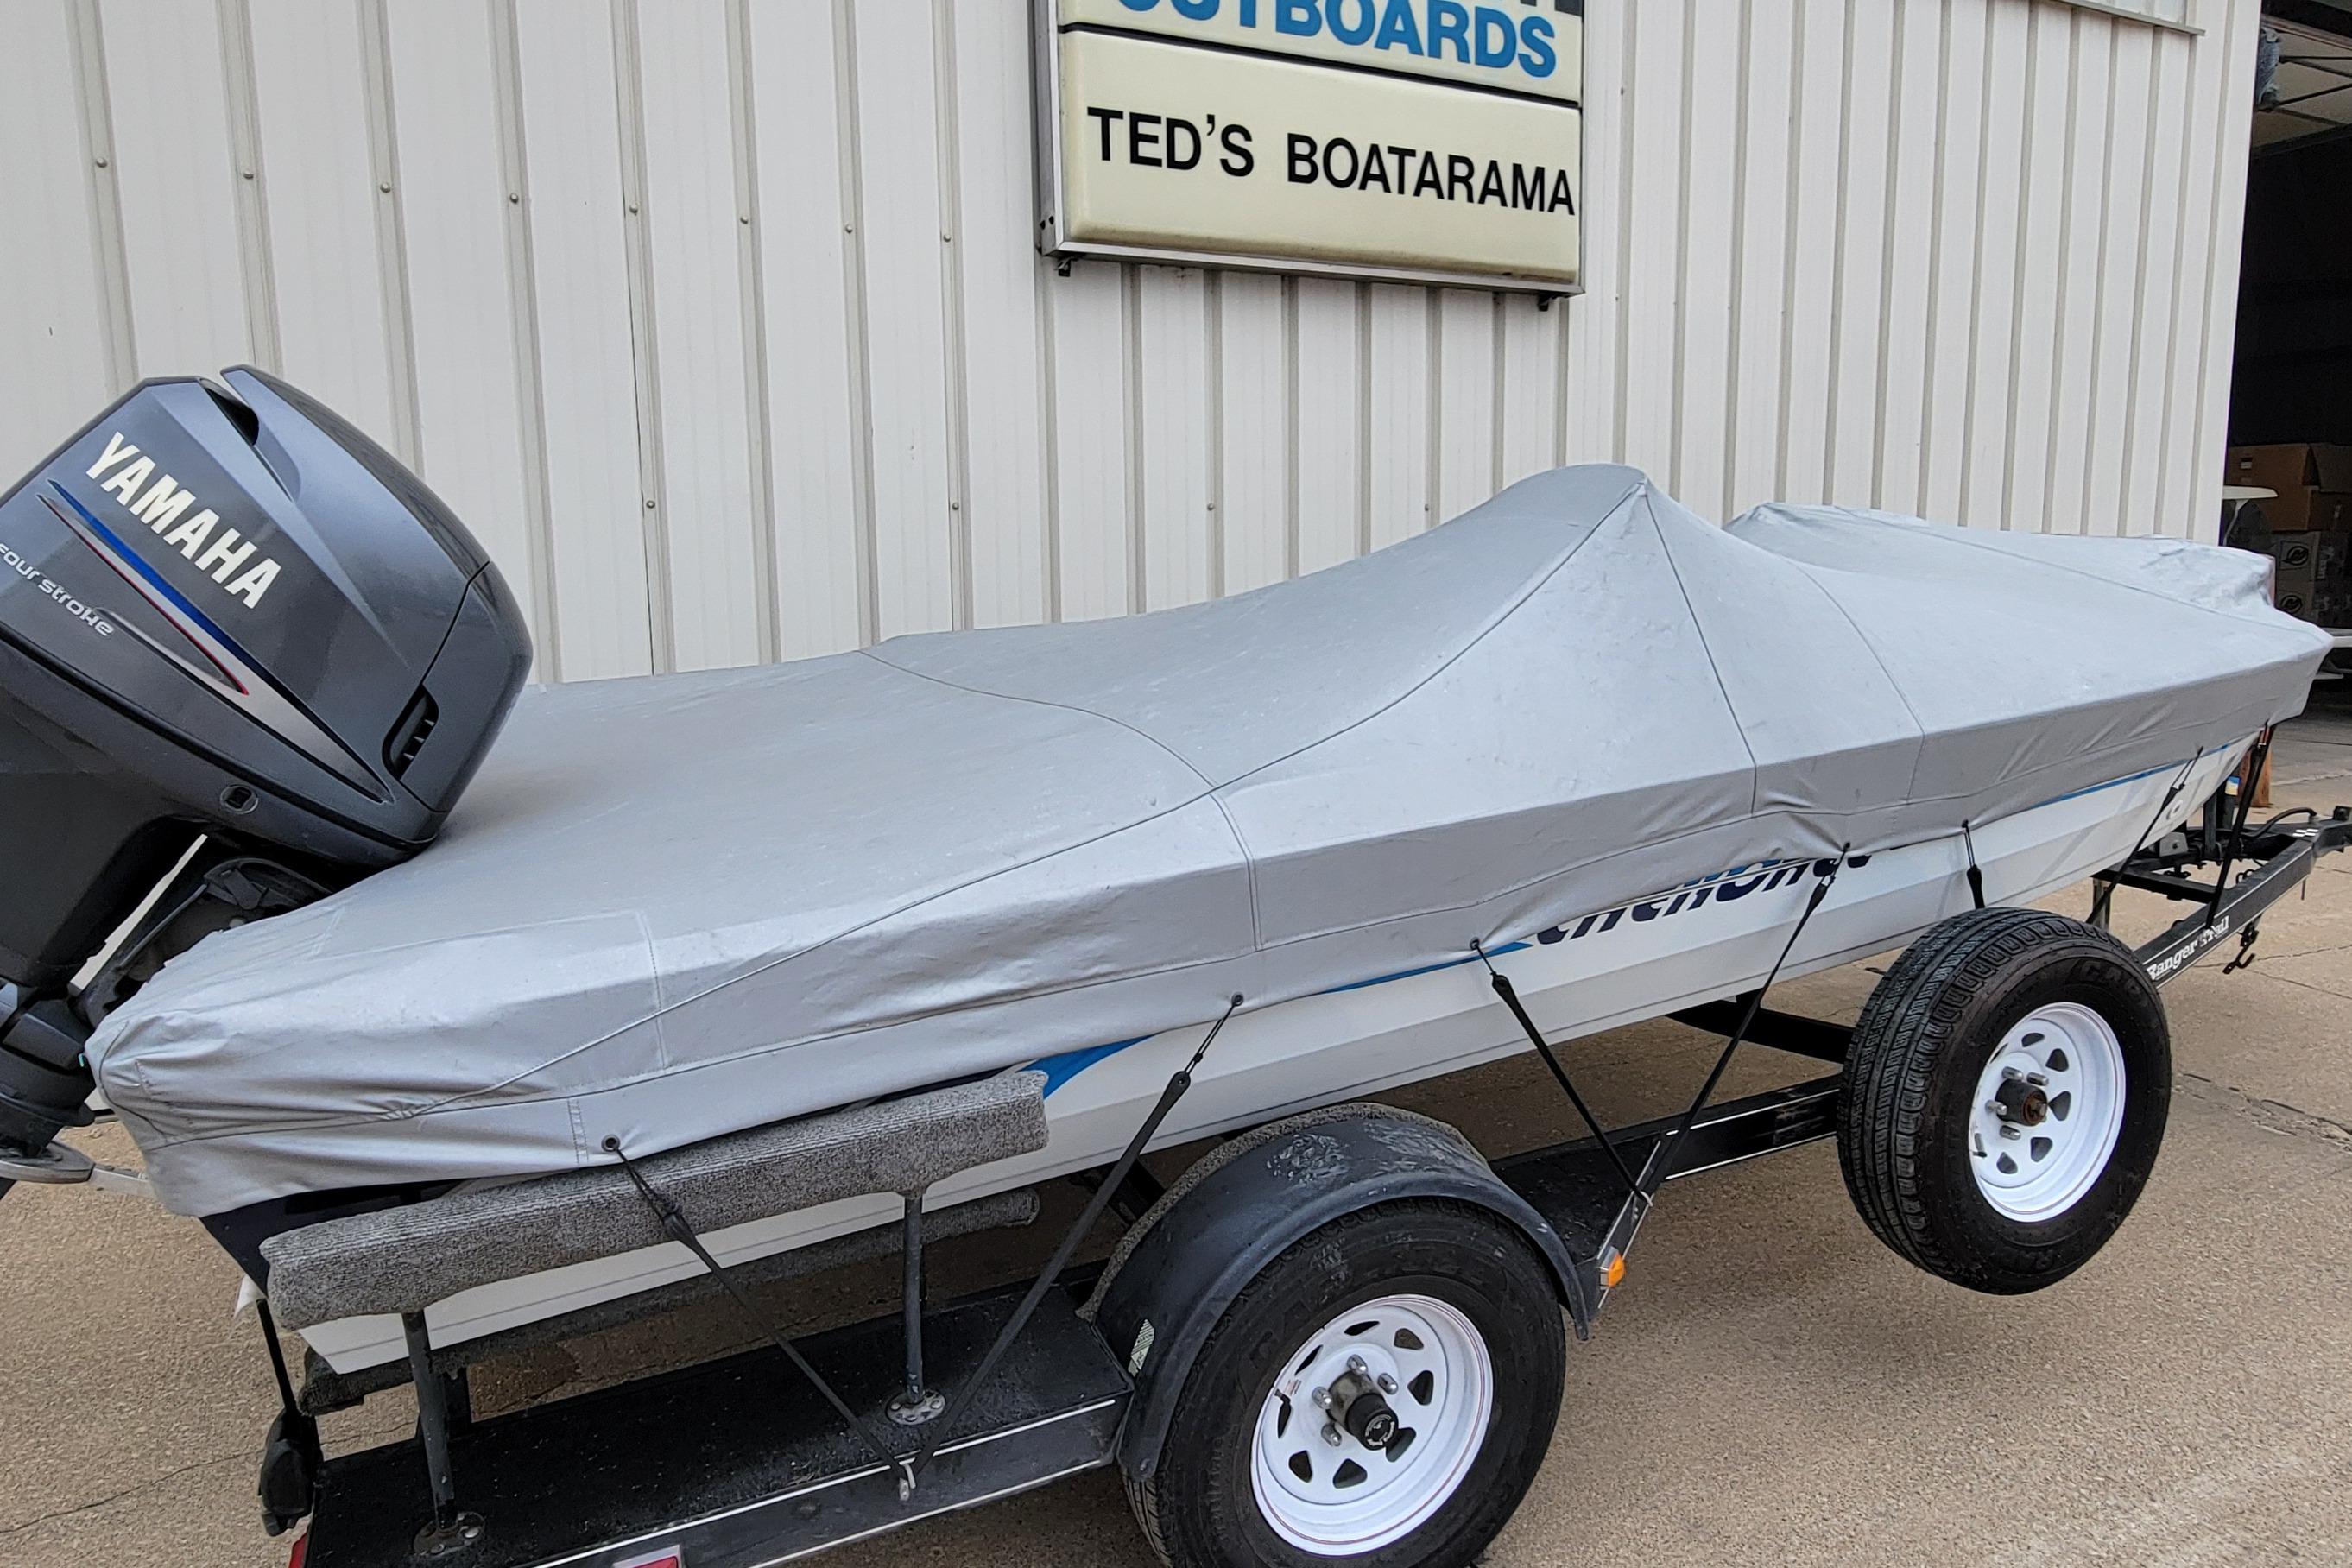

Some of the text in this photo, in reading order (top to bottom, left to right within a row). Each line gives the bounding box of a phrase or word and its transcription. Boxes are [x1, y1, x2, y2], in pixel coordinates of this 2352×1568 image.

[1118, 0, 1557, 79] BOARDS
[1086, 106, 1576, 216] TED'S BOATARAMA
[85, 432, 281, 609] YAMAHA
[2147, 939, 2198, 981] Ranger
